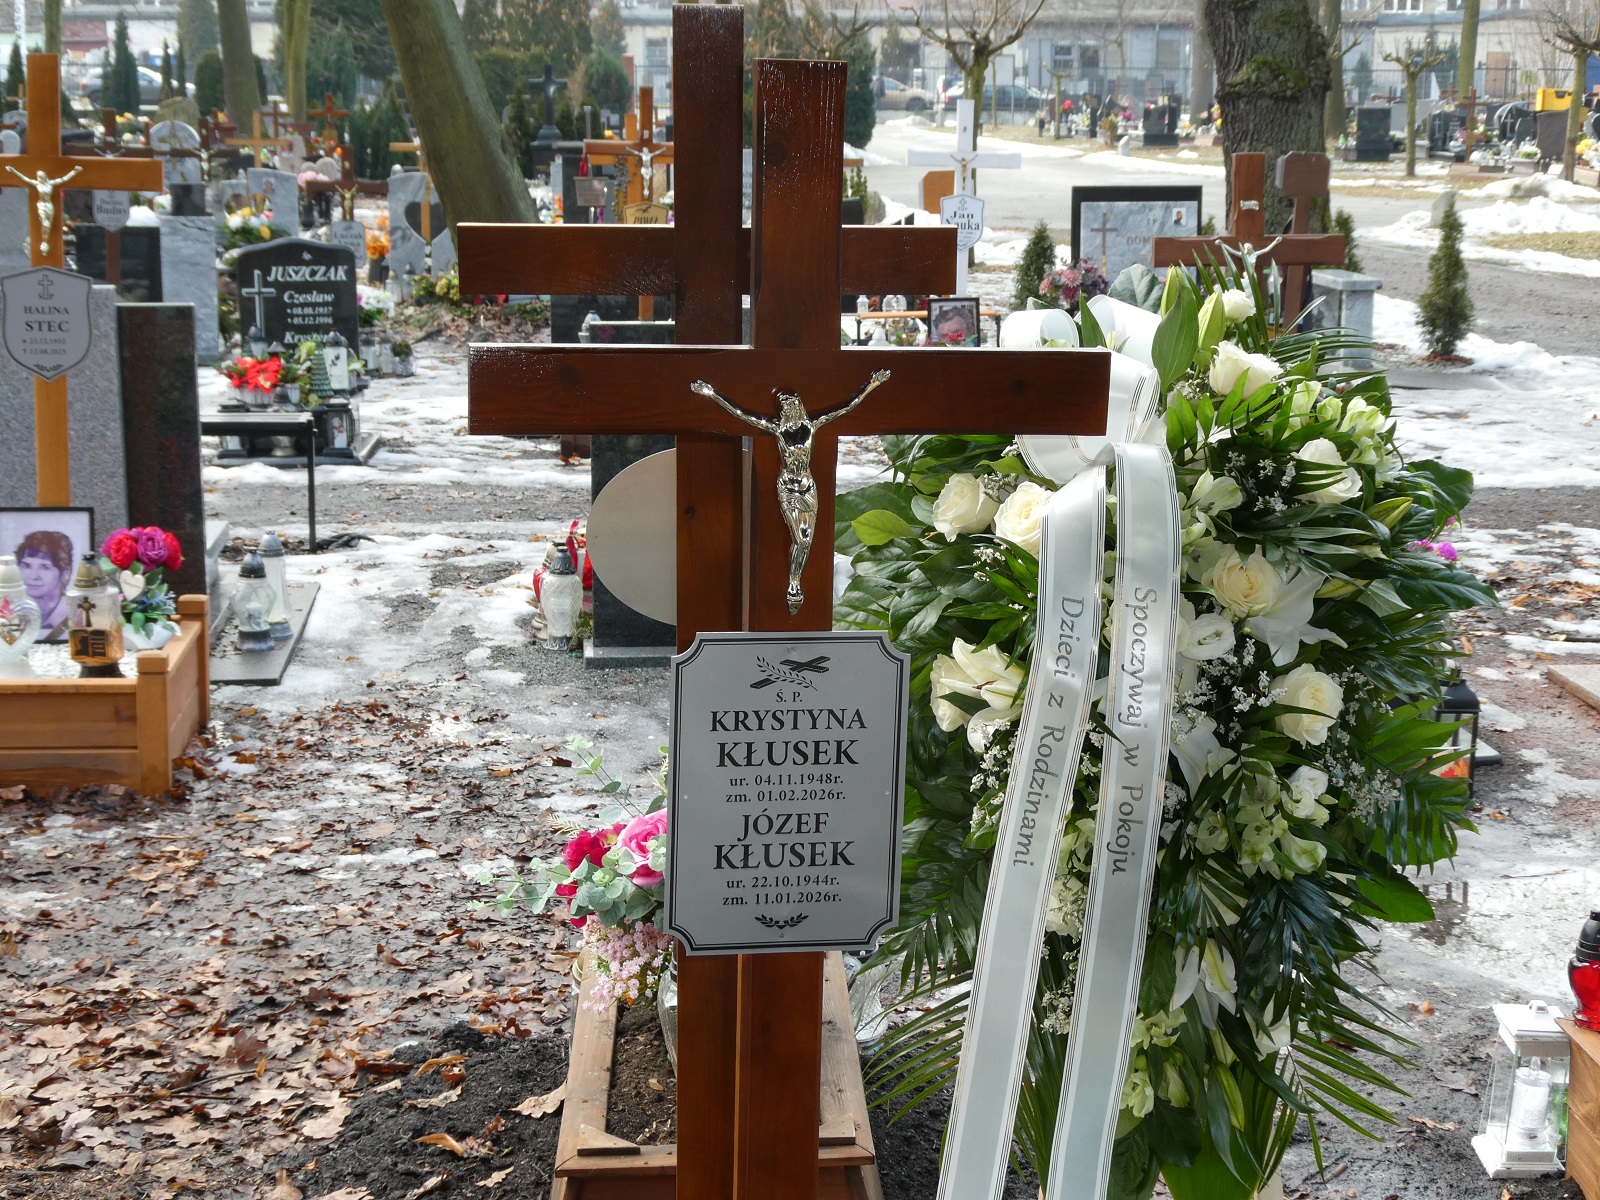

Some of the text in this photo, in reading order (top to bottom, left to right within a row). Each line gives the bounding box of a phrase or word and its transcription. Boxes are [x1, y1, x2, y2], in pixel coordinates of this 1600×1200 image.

[950, 211, 974, 219] Jan
[267, 265, 349, 282] JUSZCZAK
[283, 290, 335, 304] Czesław
[24, 305, 70, 315] HALINA
[25, 320, 70, 333] STEC
[775, 689, 803, 702] Ś. P.
[710, 708, 867, 732] KRYSTYNA
[1013, 596, 1085, 866] Dzieci z Rodzinami
[1107, 587, 1157, 875] Spoczywaj w Pokoju
[716, 739, 859, 767] KŁUSEK
[729, 773, 844, 787] ur. 04.11.1948r.
[726, 789, 846, 803] zm. 01.02.2026r.
[737, 808, 829, 841] JÓZEF
[713, 841, 855, 869] KŁUSEK
[726, 874, 840, 889] ur. 22.10.1944r.
[722, 891, 842, 906] zm. 11.01.2026r.
